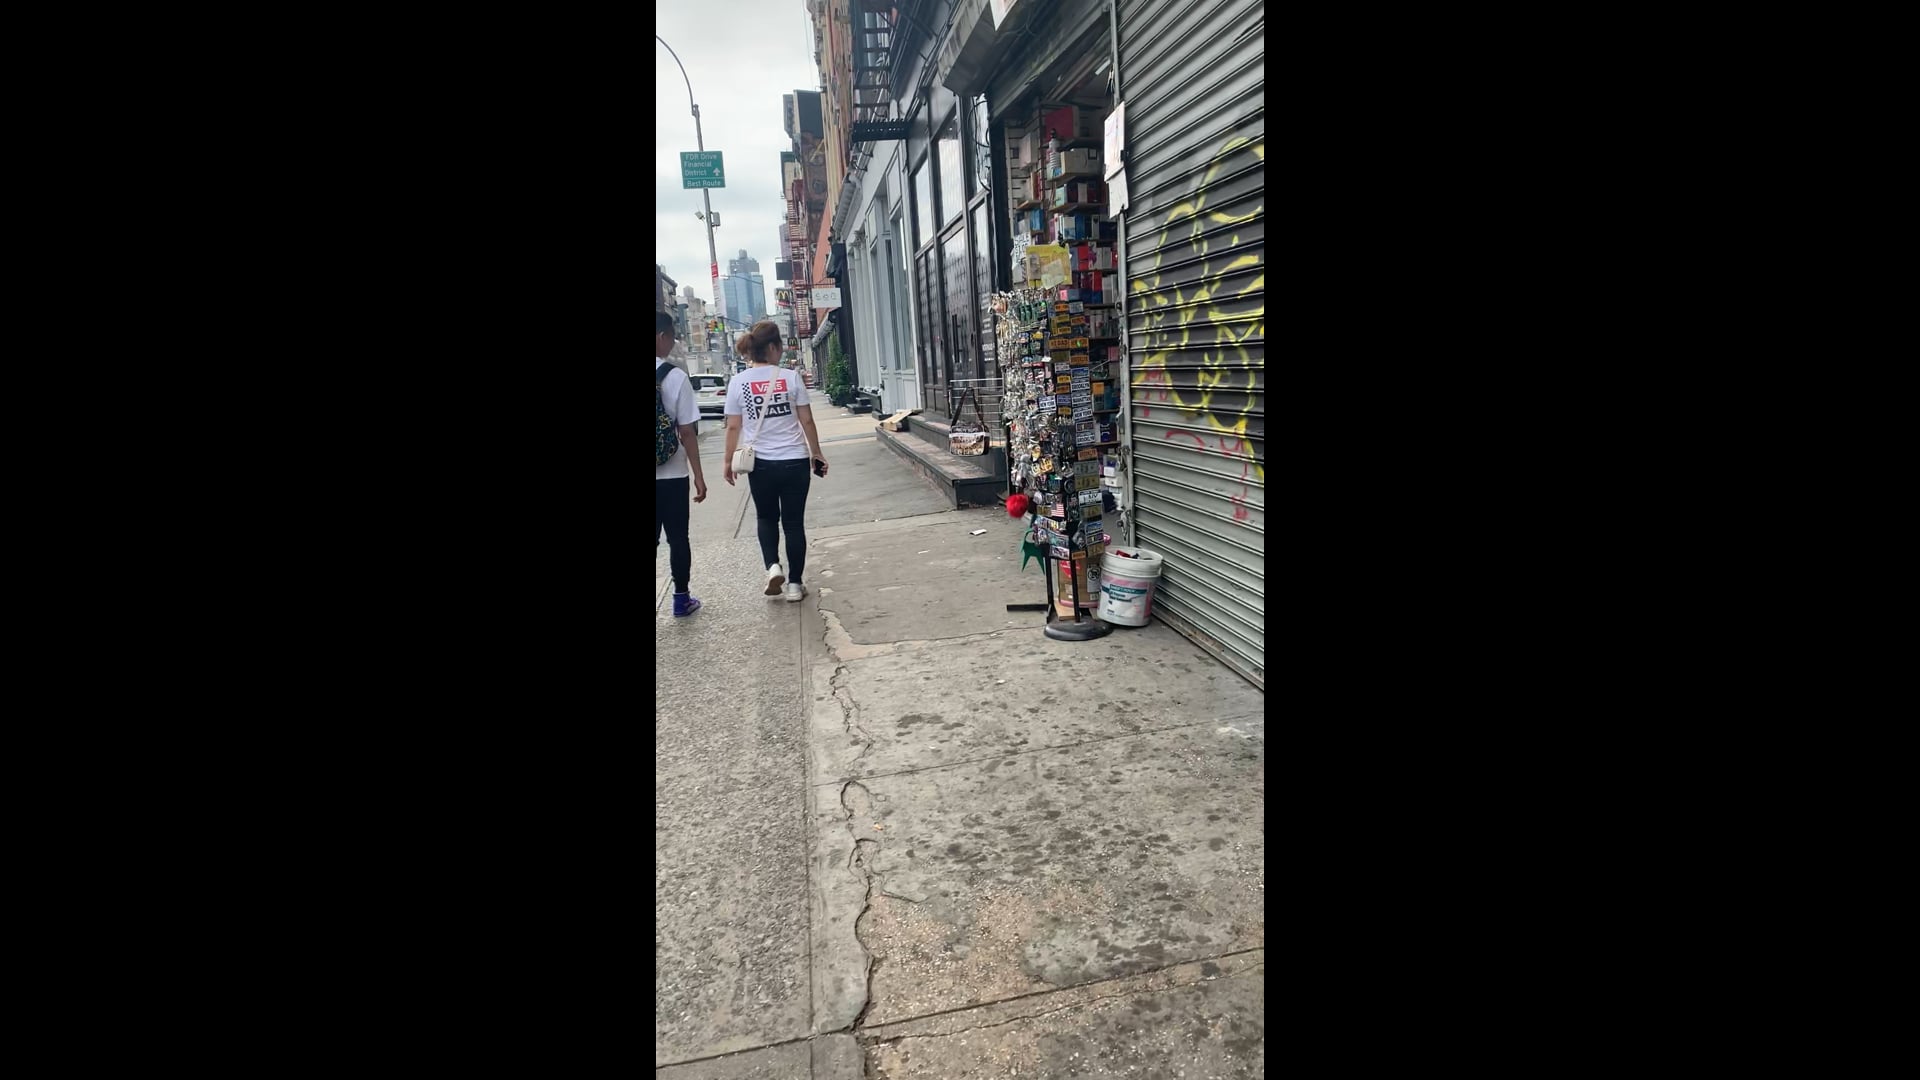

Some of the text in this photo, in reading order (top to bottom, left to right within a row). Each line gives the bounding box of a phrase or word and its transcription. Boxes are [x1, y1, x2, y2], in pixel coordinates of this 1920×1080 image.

[683, 160, 712, 168] Financial
[702, 179, 721, 187] Route
[755, 381, 783, 392] VAS
[753, 393, 782, 405] OF
